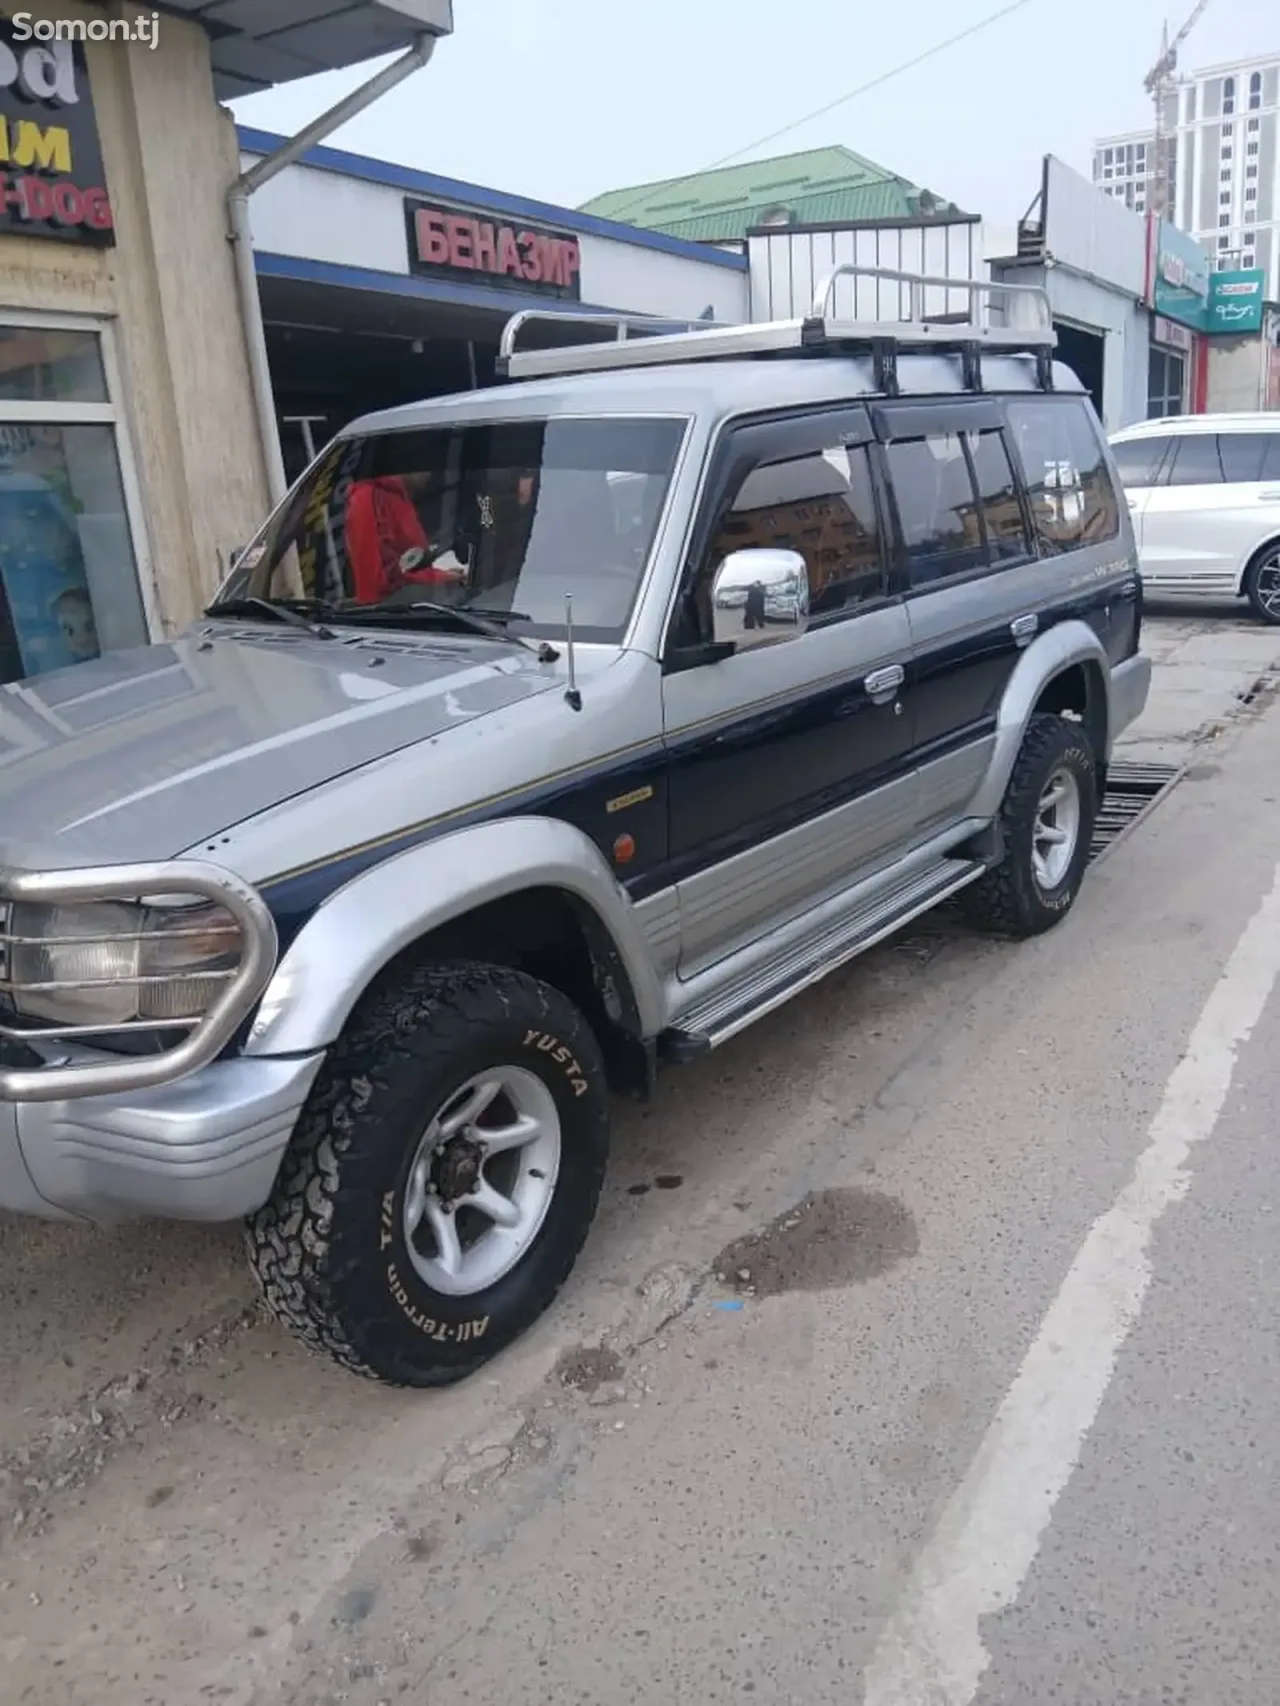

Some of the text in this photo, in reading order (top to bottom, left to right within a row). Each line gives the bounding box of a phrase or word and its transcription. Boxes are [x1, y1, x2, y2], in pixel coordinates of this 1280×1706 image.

[415, 208, 582, 287] БЕНАЗИР
[522, 1029, 589, 1098] YUSTA
[380, 1190, 490, 1343] All-Terrain T/A
